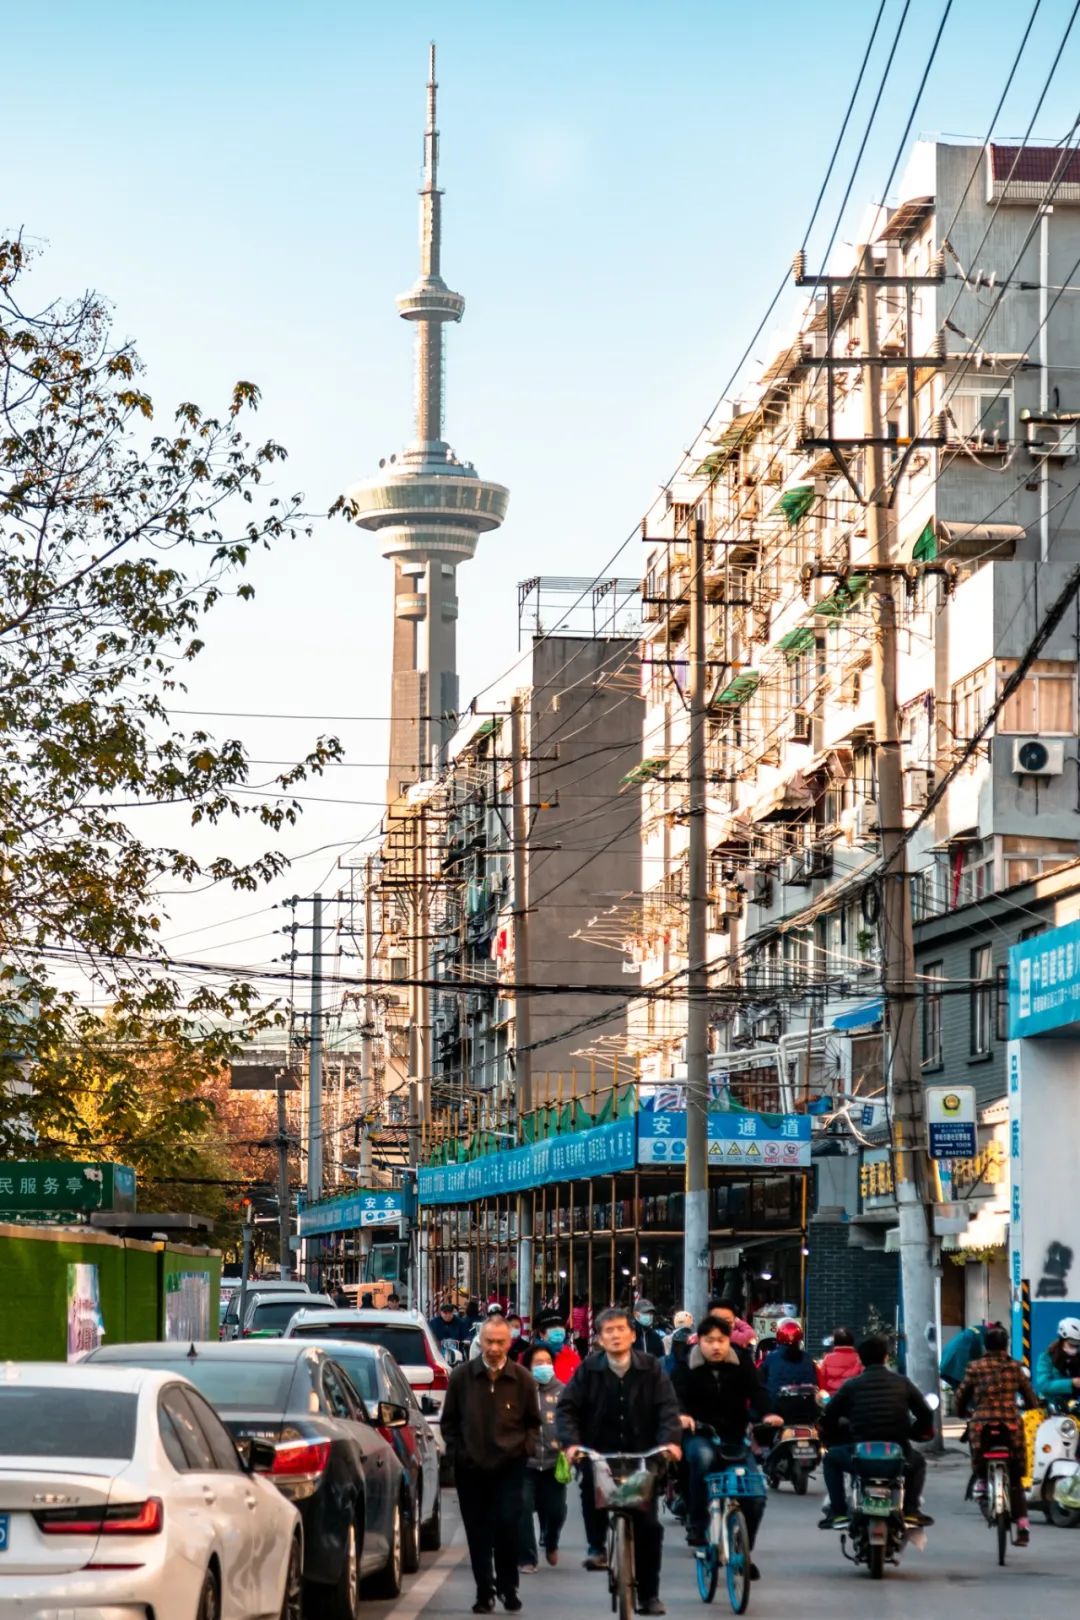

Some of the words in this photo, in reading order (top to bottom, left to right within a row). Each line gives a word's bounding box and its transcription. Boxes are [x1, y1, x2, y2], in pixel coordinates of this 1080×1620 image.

[0, 1176, 84, 1195] 民服务亭
[364, 1196, 396, 1209] 安全
